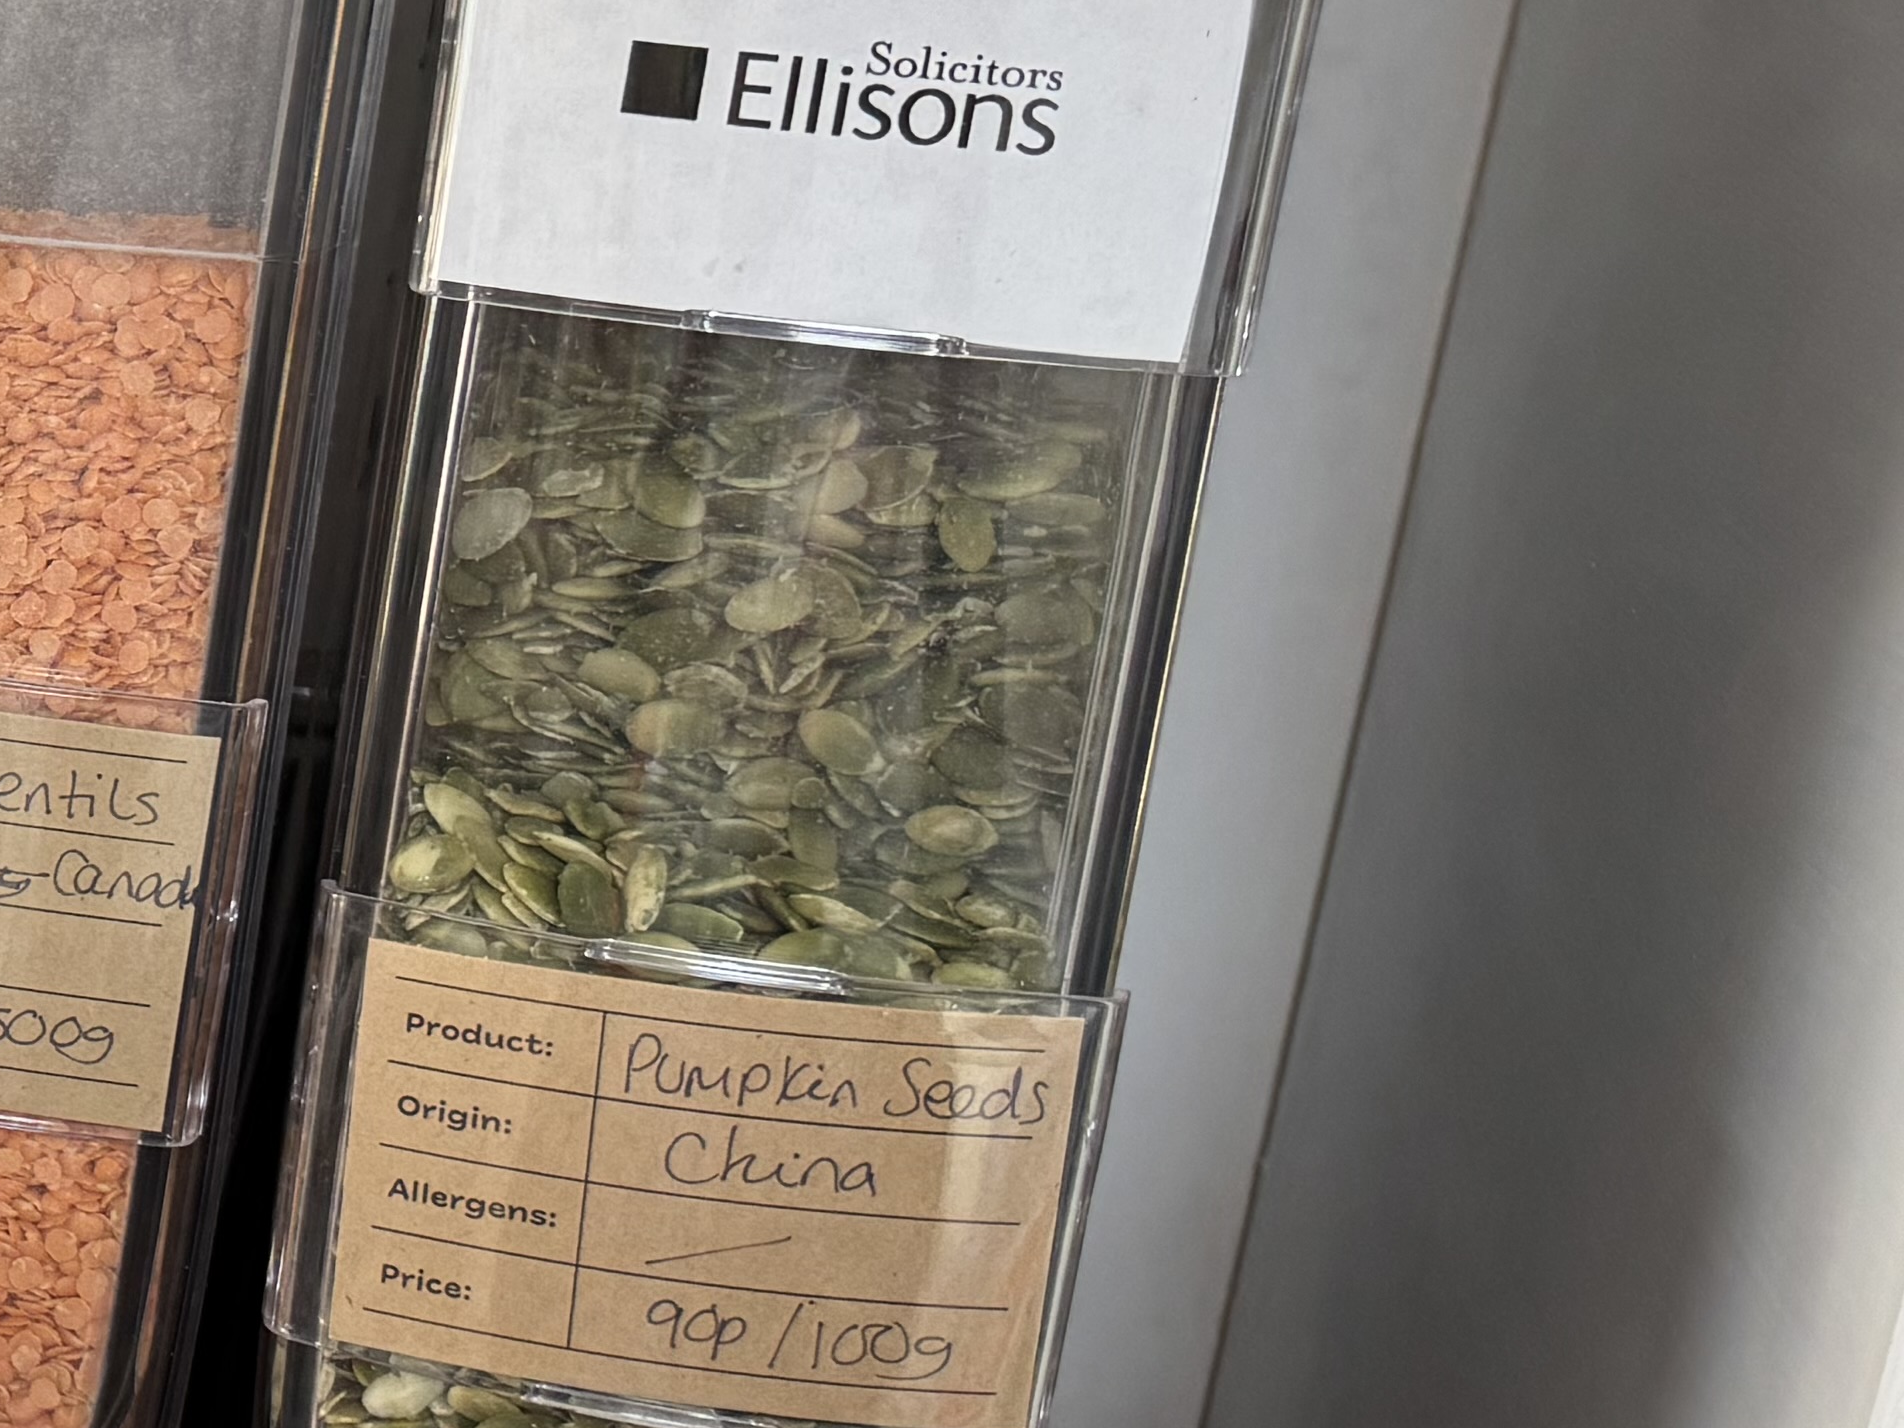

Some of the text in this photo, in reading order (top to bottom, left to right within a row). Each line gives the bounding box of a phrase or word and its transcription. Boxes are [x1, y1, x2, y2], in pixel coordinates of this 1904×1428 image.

[726, 50, 1060, 157] Ellisons
[866, 41, 1064, 93] Solicitors
[405, 1013, 1052, 1126] Product: Pumpkin Seeds
[396, 1095, 877, 1198] Origin: China
[387, 1176, 558, 1230] Allergens:
[381, 1263, 473, 1303] Price:
[646, 1298, 748, 1361] 90p
